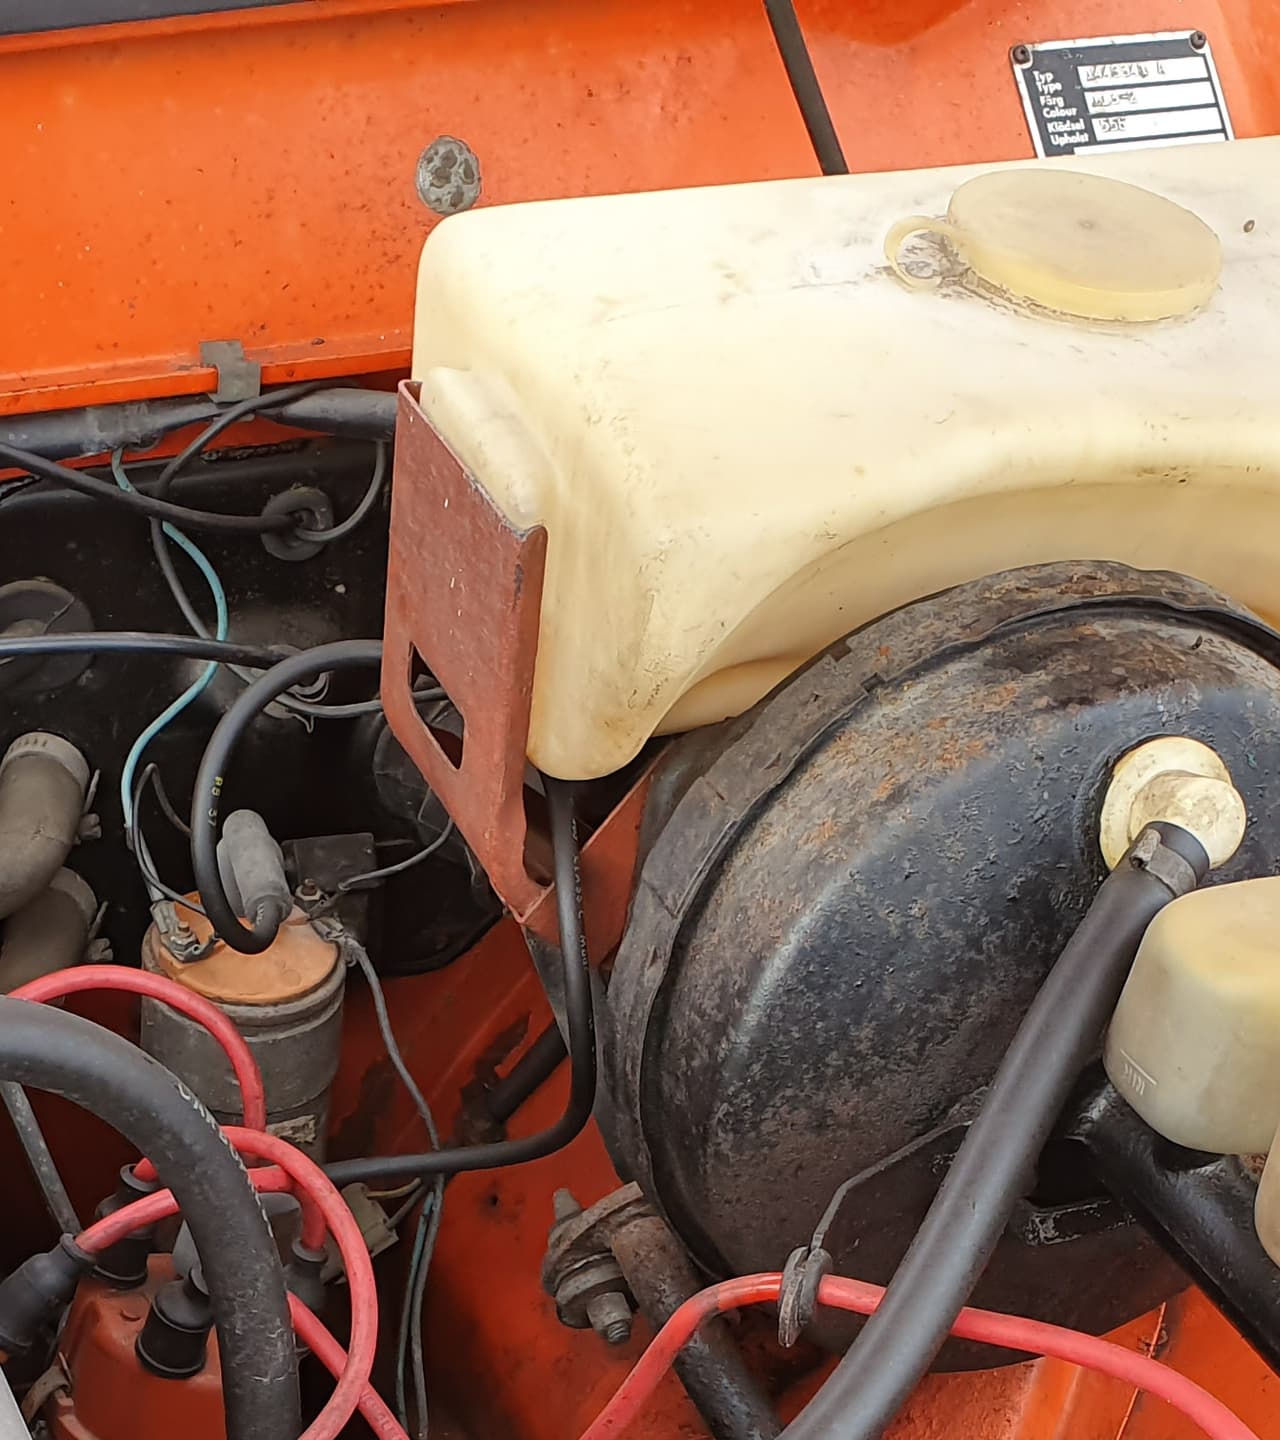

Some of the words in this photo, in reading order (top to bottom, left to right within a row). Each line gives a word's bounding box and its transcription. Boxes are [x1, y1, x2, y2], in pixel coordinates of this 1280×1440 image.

[1032, 70, 1054, 84] Typ
[1036, 82, 1062, 94] Type
[1039, 95, 1065, 108] Färg
[1042, 106, 1078, 118] Colour
[1046, 117, 1086, 134] Klädsel
